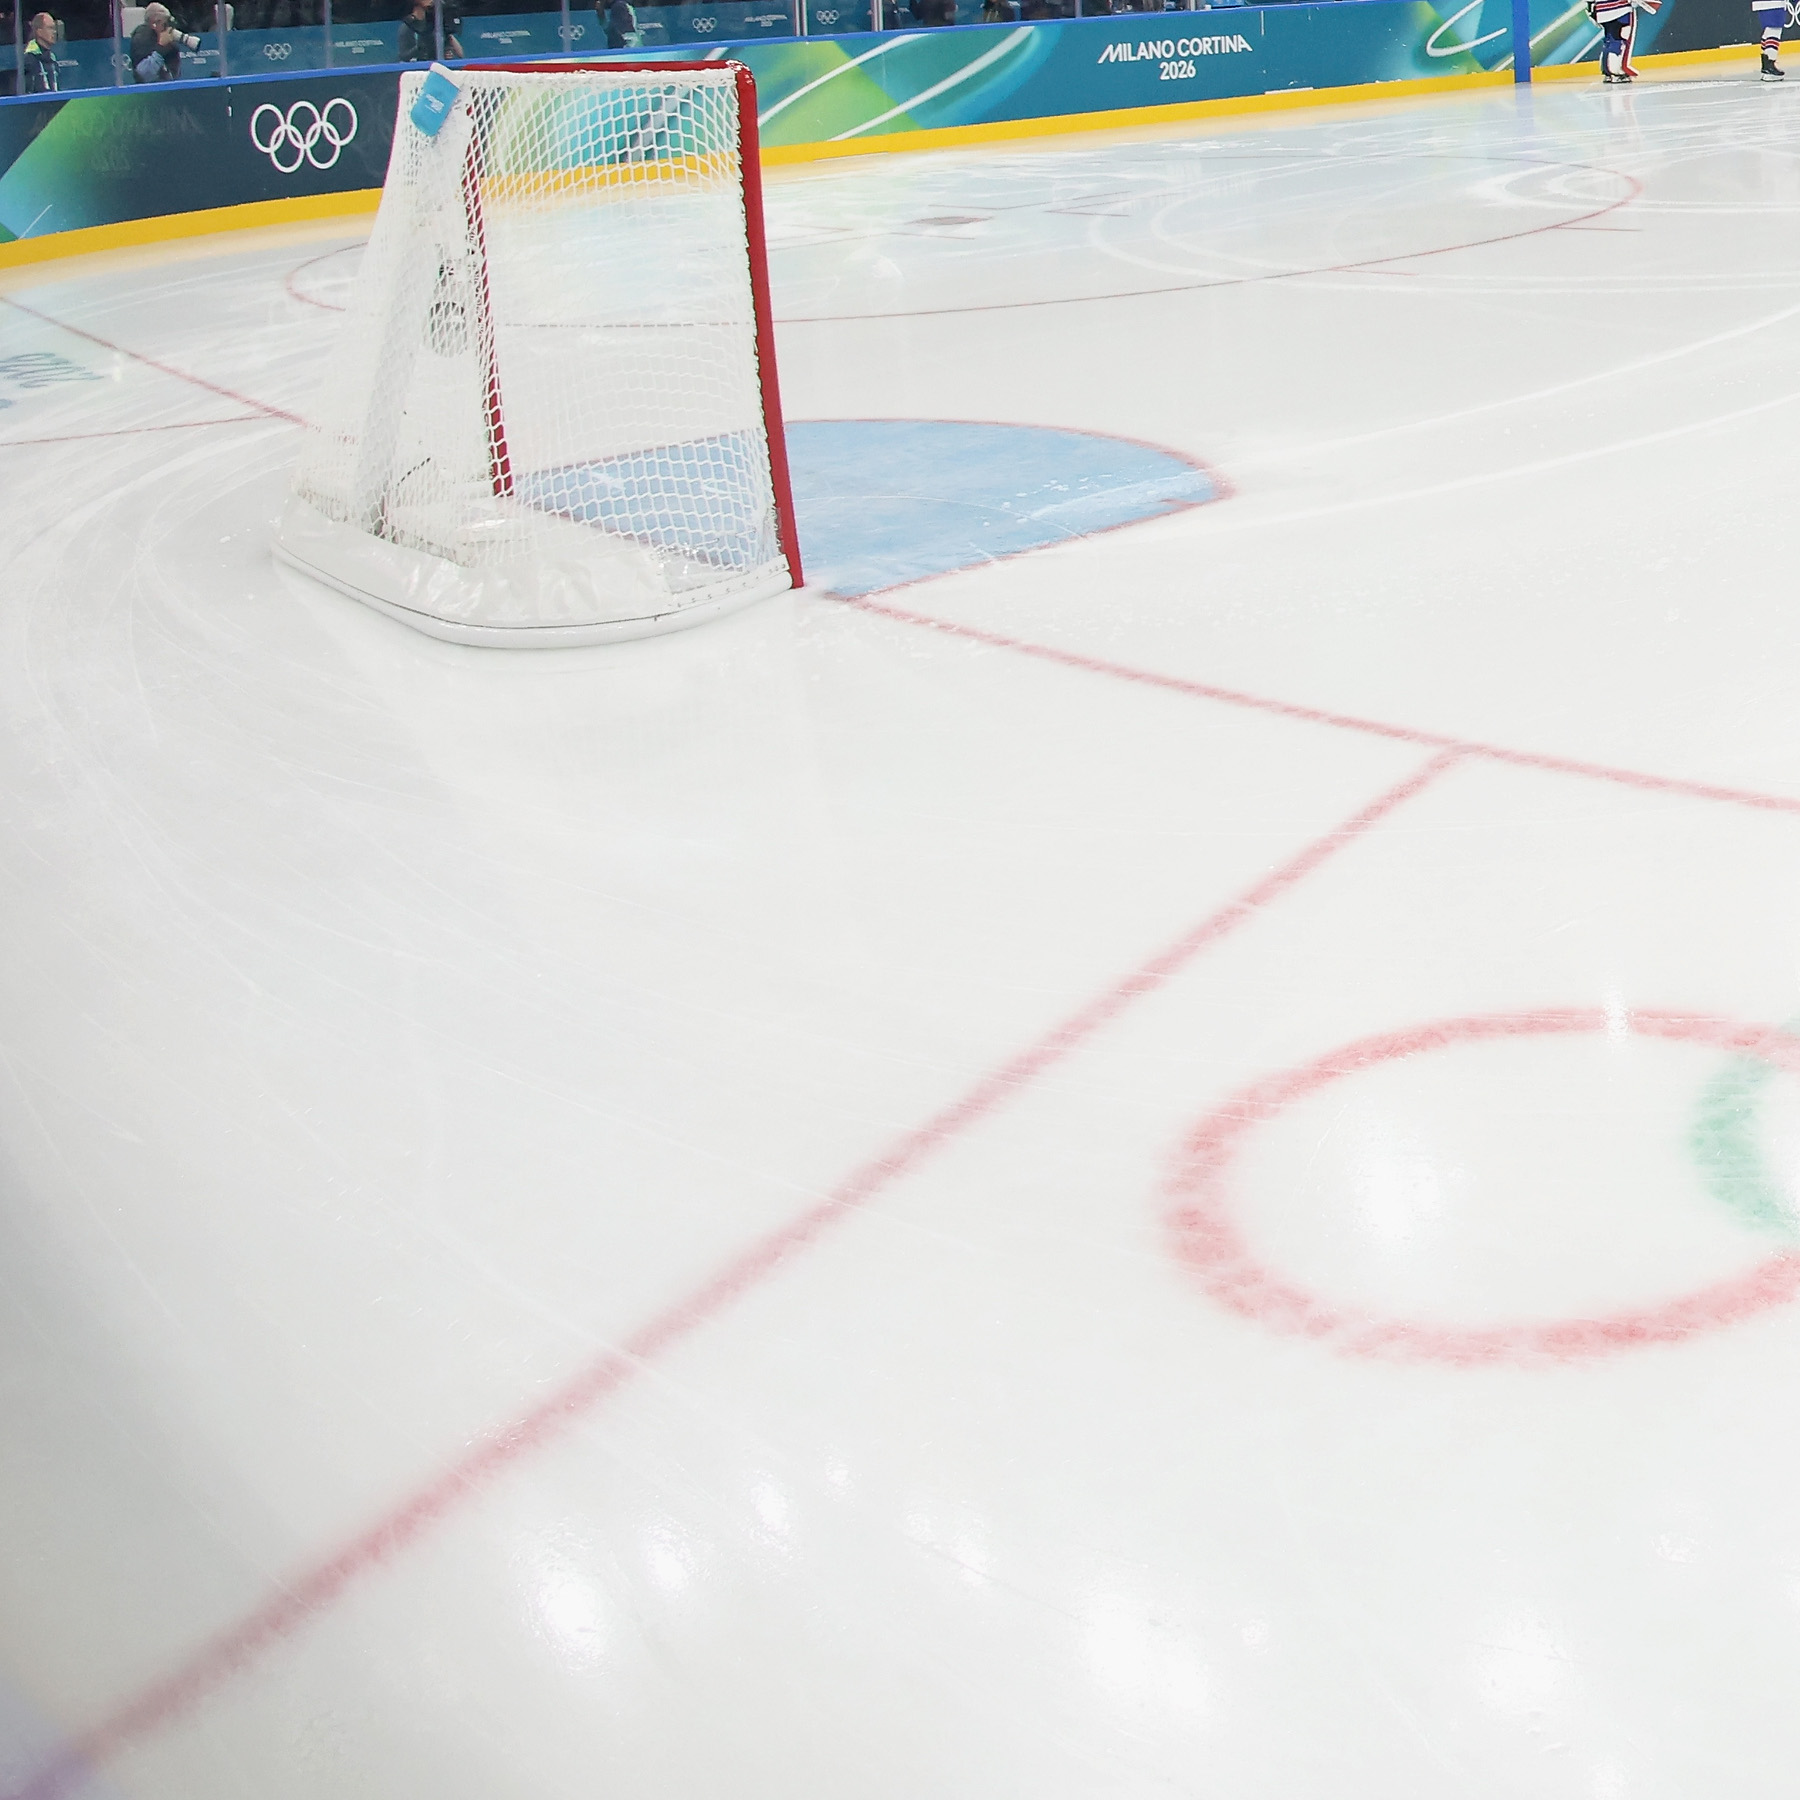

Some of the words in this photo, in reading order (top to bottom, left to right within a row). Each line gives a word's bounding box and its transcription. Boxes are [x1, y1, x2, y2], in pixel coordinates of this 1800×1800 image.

[1097, 39, 1176, 64] MILANO
[1176, 34, 1253, 58] CORTINA
[1159, 60, 1197, 80] 2026
